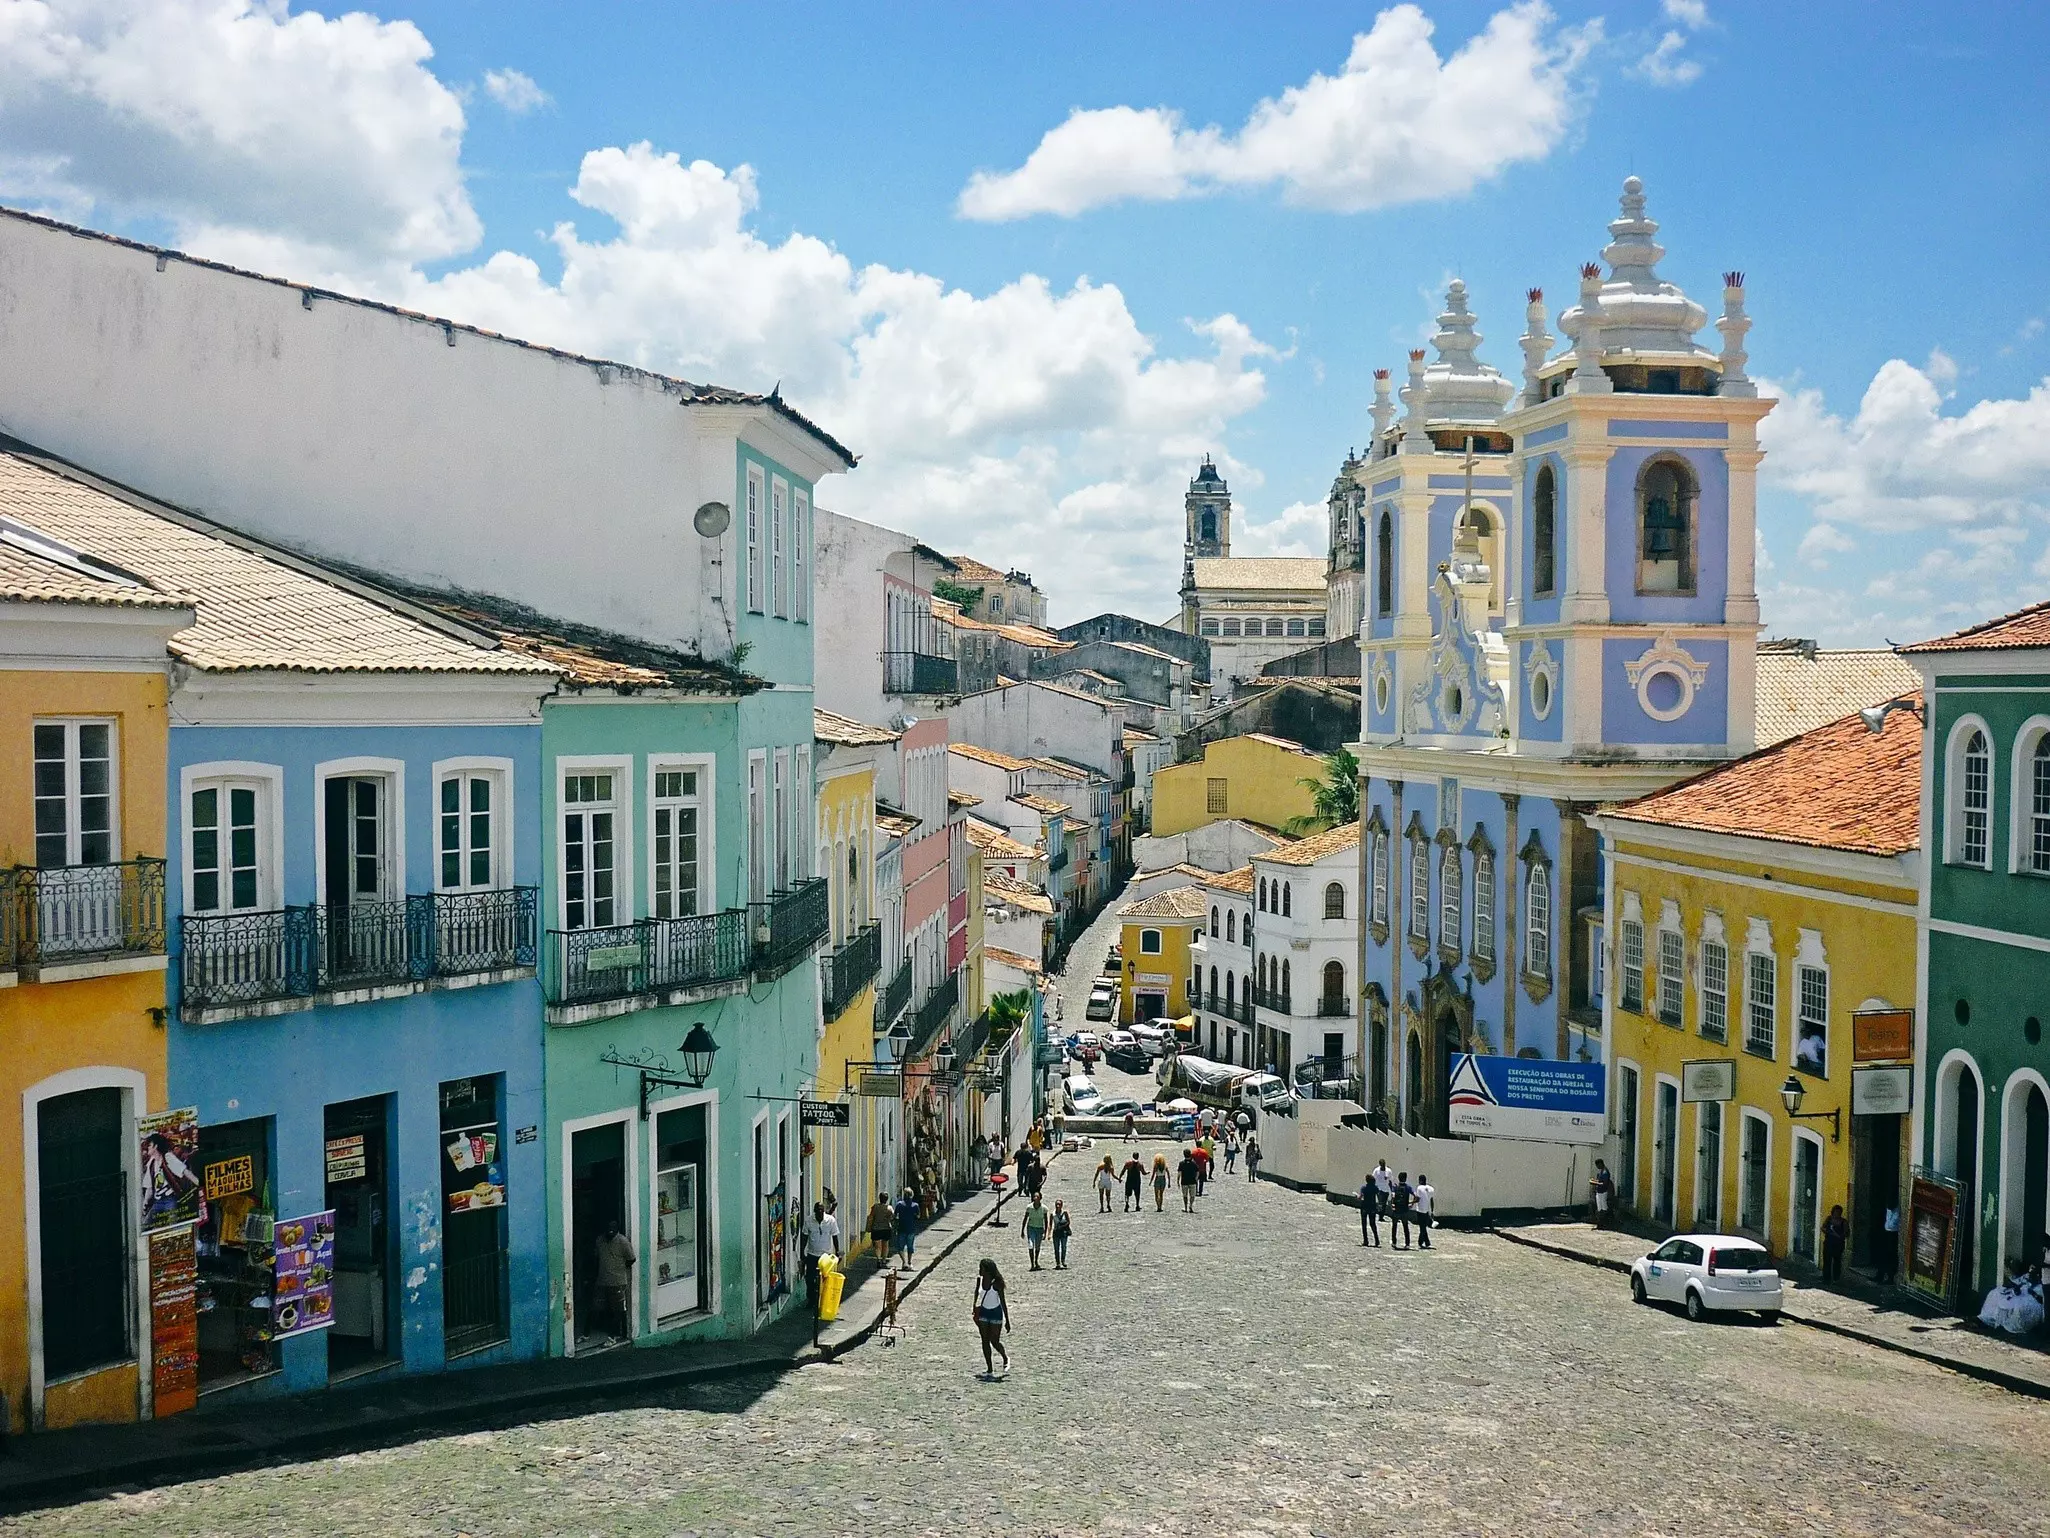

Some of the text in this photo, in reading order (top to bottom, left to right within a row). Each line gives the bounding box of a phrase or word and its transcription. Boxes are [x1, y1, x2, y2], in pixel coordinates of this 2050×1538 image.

[1508, 1068, 1539, 1077] EXECUÇÃO
[1508, 1077, 1551, 1085] RESTAURAÇÃO
[1530, 1086, 1558, 1094] SENHORA
[1521, 1093, 1544, 1101] PRETOS
[207, 1159, 250, 1180] FILMES
[208, 1179, 251, 1198] E PILHAS
